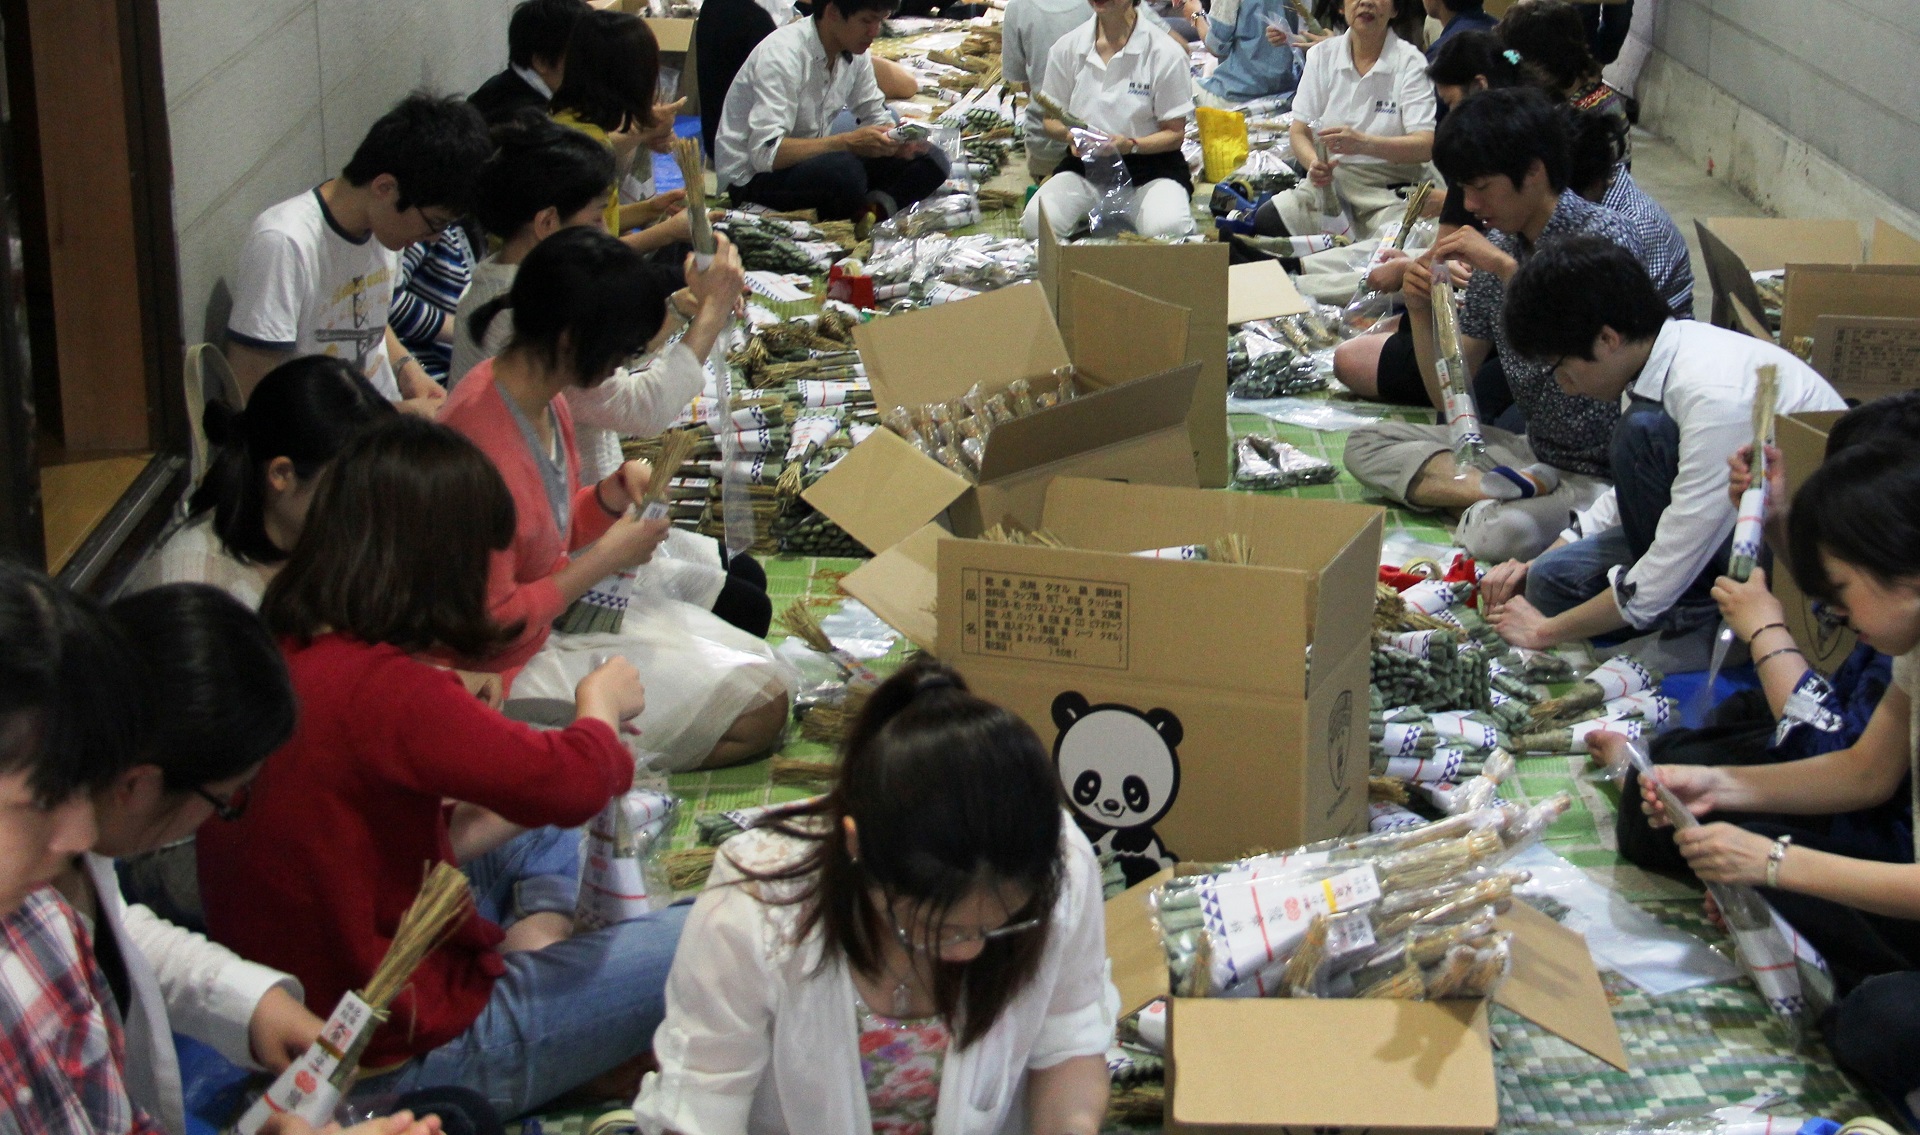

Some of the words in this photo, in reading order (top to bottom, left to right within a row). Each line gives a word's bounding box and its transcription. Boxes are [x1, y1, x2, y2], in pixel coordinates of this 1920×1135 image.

[1045, 583, 1070, 593] タオル
[965, 588, 976, 601] 品
[965, 622, 976, 635] 名
[1089, 619, 1122, 631] ビデオテープ
